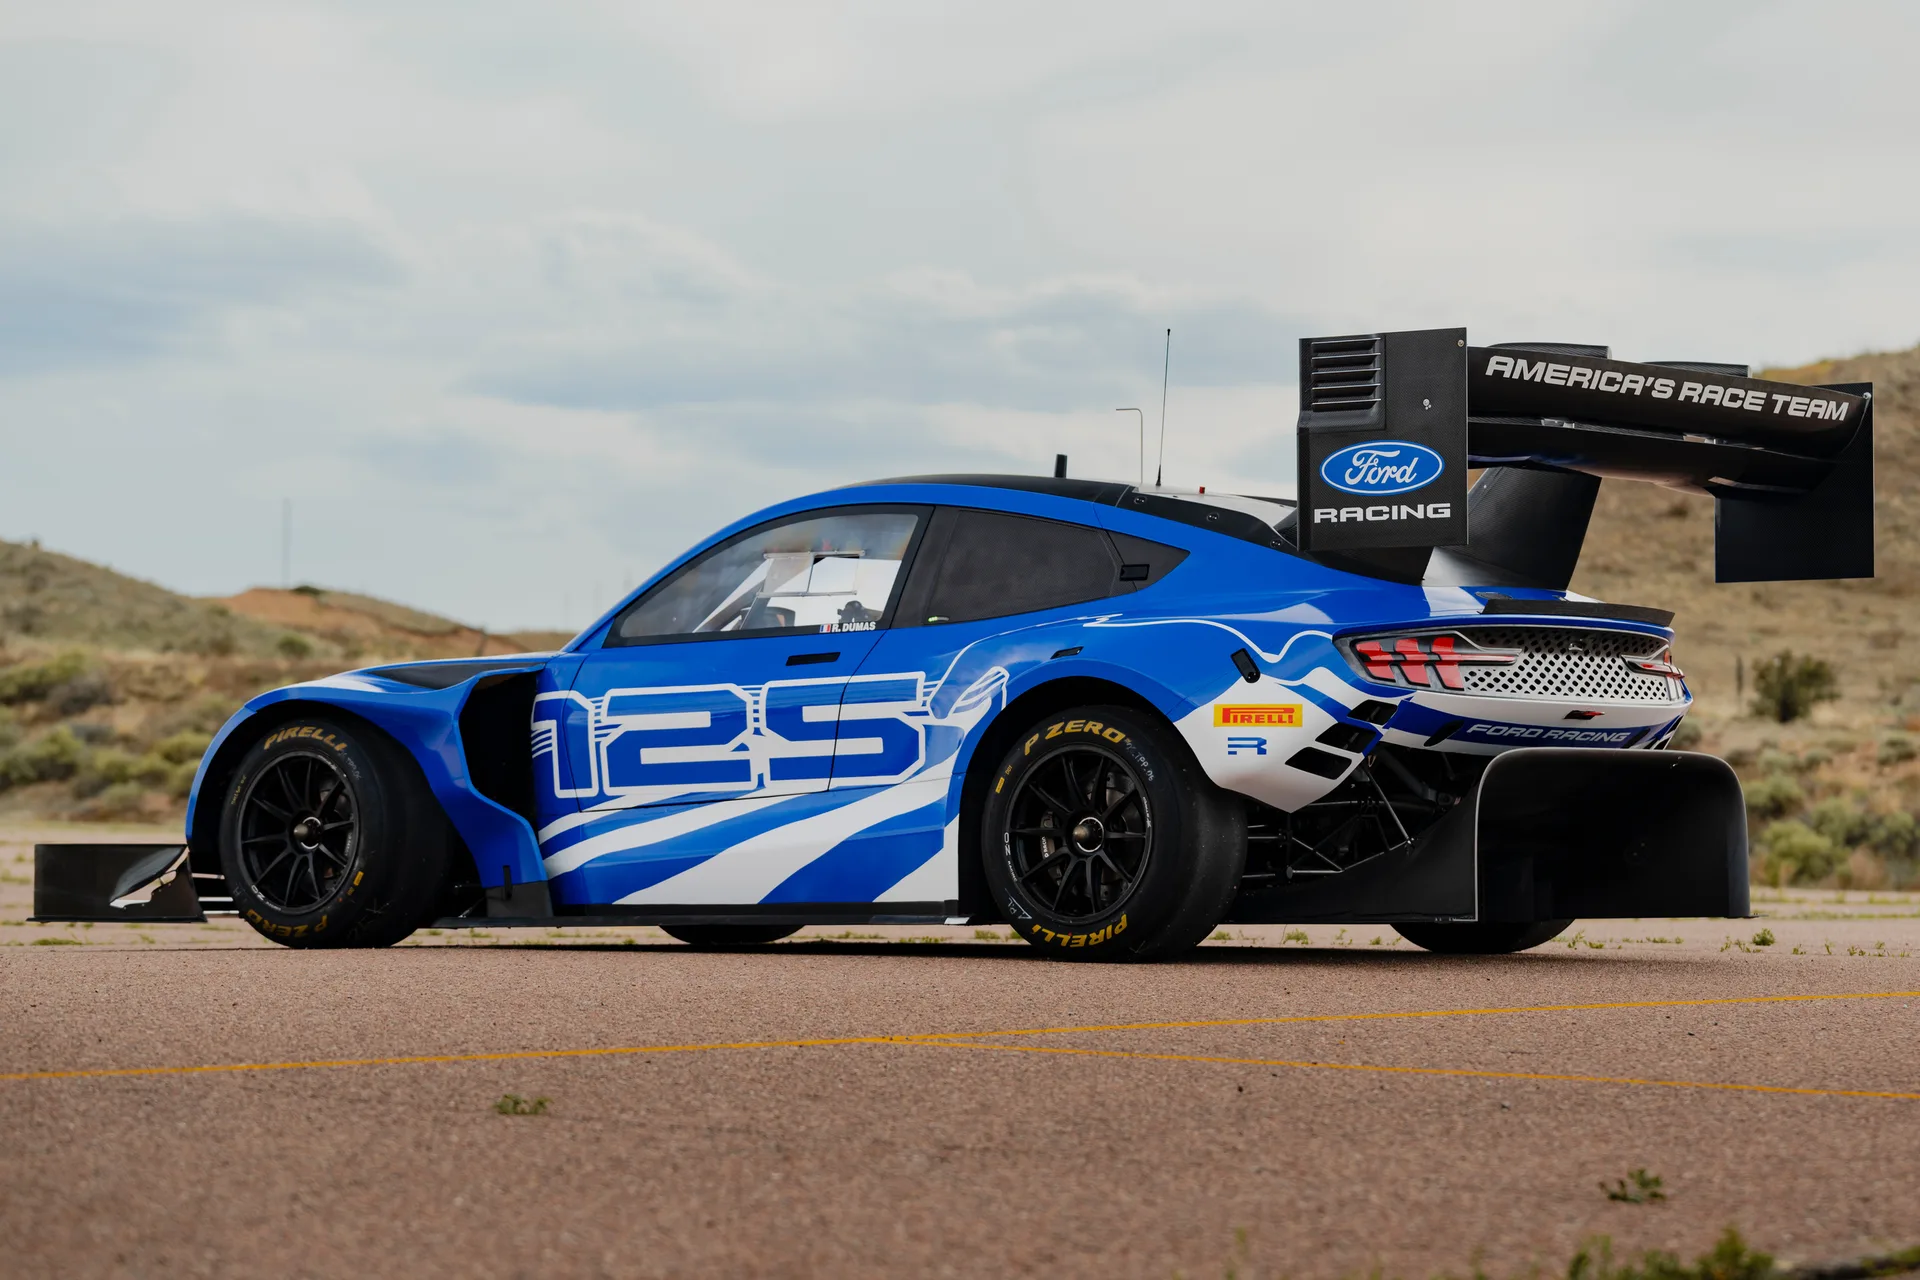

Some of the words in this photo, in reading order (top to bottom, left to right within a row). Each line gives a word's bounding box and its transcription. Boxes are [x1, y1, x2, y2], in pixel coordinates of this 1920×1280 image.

[1485, 355, 1676, 399] AMERICA'S
[1678, 382, 1768, 412] RACE
[1771, 393, 1850, 421] TEAM
[1345, 450, 1419, 485] Ford
[1314, 503, 1451, 524] RACING
[832, 623, 841, 633] R.
[842, 621, 876, 632] DUMAS
[1222, 708, 1295, 724] PIRELLI
[264, 726, 348, 751] PIRELLI
[531, 671, 926, 799] 125
[1024, 733, 1039, 756] P
[1045, 719, 1126, 743] ZERO
[1466, 724, 1545, 738] FORD
[1542, 730, 1631, 742] RACING
[246, 908, 309, 938] ZERO
[314, 915, 328, 932] P
[1031, 913, 1128, 948] PIRELLI
